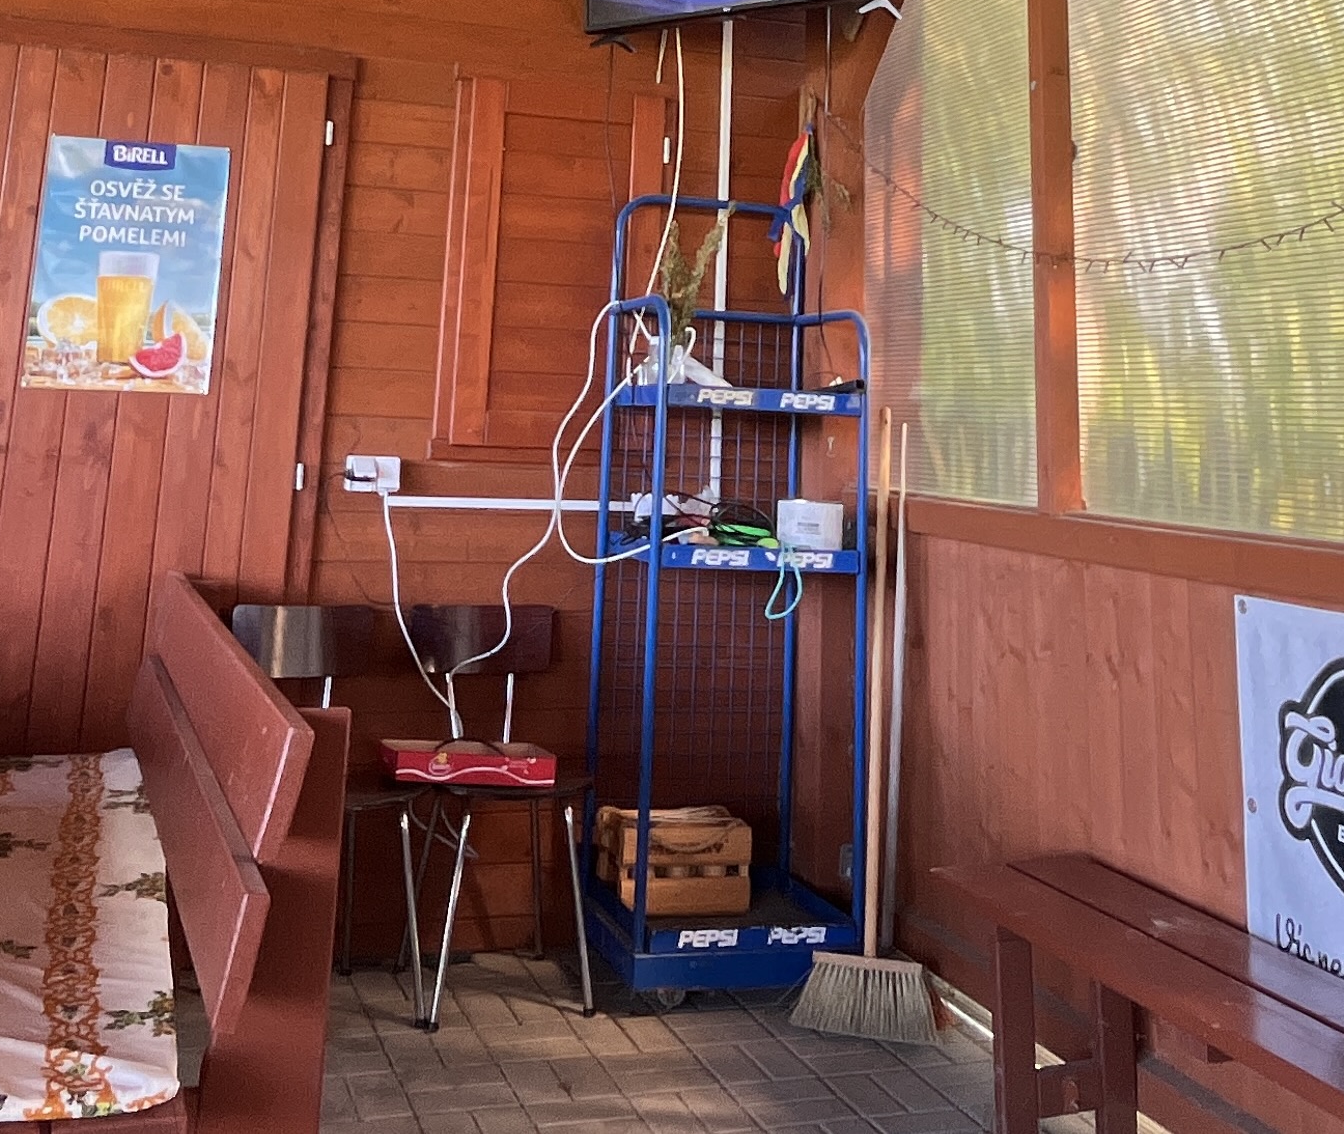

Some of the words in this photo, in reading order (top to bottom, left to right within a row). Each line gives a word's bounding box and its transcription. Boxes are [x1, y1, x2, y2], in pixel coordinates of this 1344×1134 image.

[90, 178, 158, 198] OSVĚŽ
[161, 183, 186, 202] SE
[74, 197, 195, 225] ŠŤAVNATÝM
[697, 389, 754, 406] PEPSI
[779, 392, 835, 411] PEPSI
[691, 548, 750, 566] PEPSI
[677, 929, 739, 949] PEPSI
